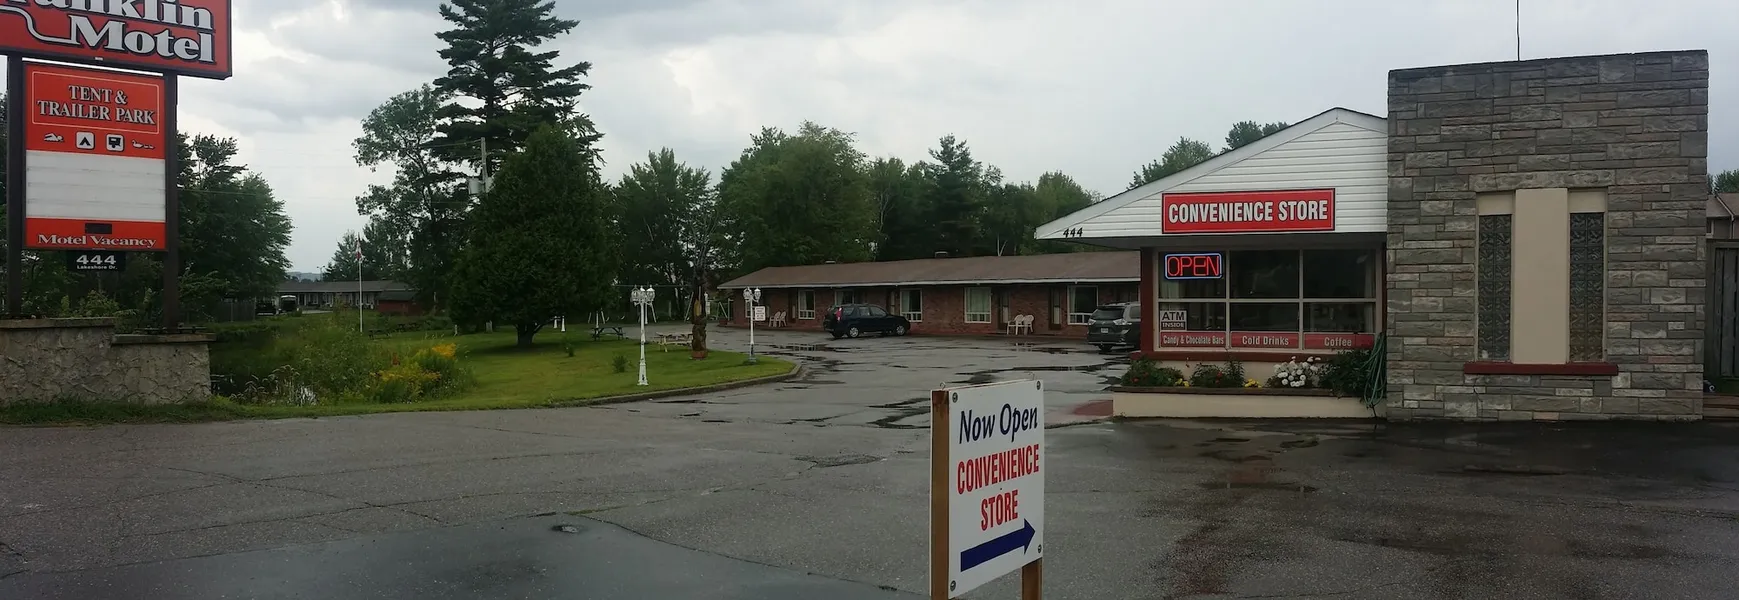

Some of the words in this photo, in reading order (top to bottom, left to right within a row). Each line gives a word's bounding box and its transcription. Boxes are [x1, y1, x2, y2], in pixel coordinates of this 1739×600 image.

[69, 15, 214, 62] Motel
[69, 85, 112, 102] TENT
[115, 90, 127, 104] &
[37, 100, 110, 121] TRAILER
[116, 107, 156, 124] PARK
[1168, 202, 1273, 224] CONVENIENCE
[1278, 200, 1328, 221] STORE
[38, 234, 86, 245] Motel
[90, 235, 157, 248] Vacancy
[1063, 227, 1083, 238] 444
[76, 254, 117, 265] 444
[1167, 256, 1220, 276] OPEN
[1162, 311, 1185, 321] ATM
[1163, 335, 1179, 346] Candy
[1180, 335, 1185, 344] &
[1185, 335, 1211, 344] Chocolate
[1212, 335, 1225, 345] Bars
[1242, 335, 1261, 345] Cold
[1263, 335, 1289, 346] Drinks
[1324, 336, 1352, 347] Coffee
[959, 410, 995, 444] Now
[1000, 403, 1038, 442] Open
[957, 444, 1039, 494] CONVENIENCE
[981, 490, 1018, 531] STORE
